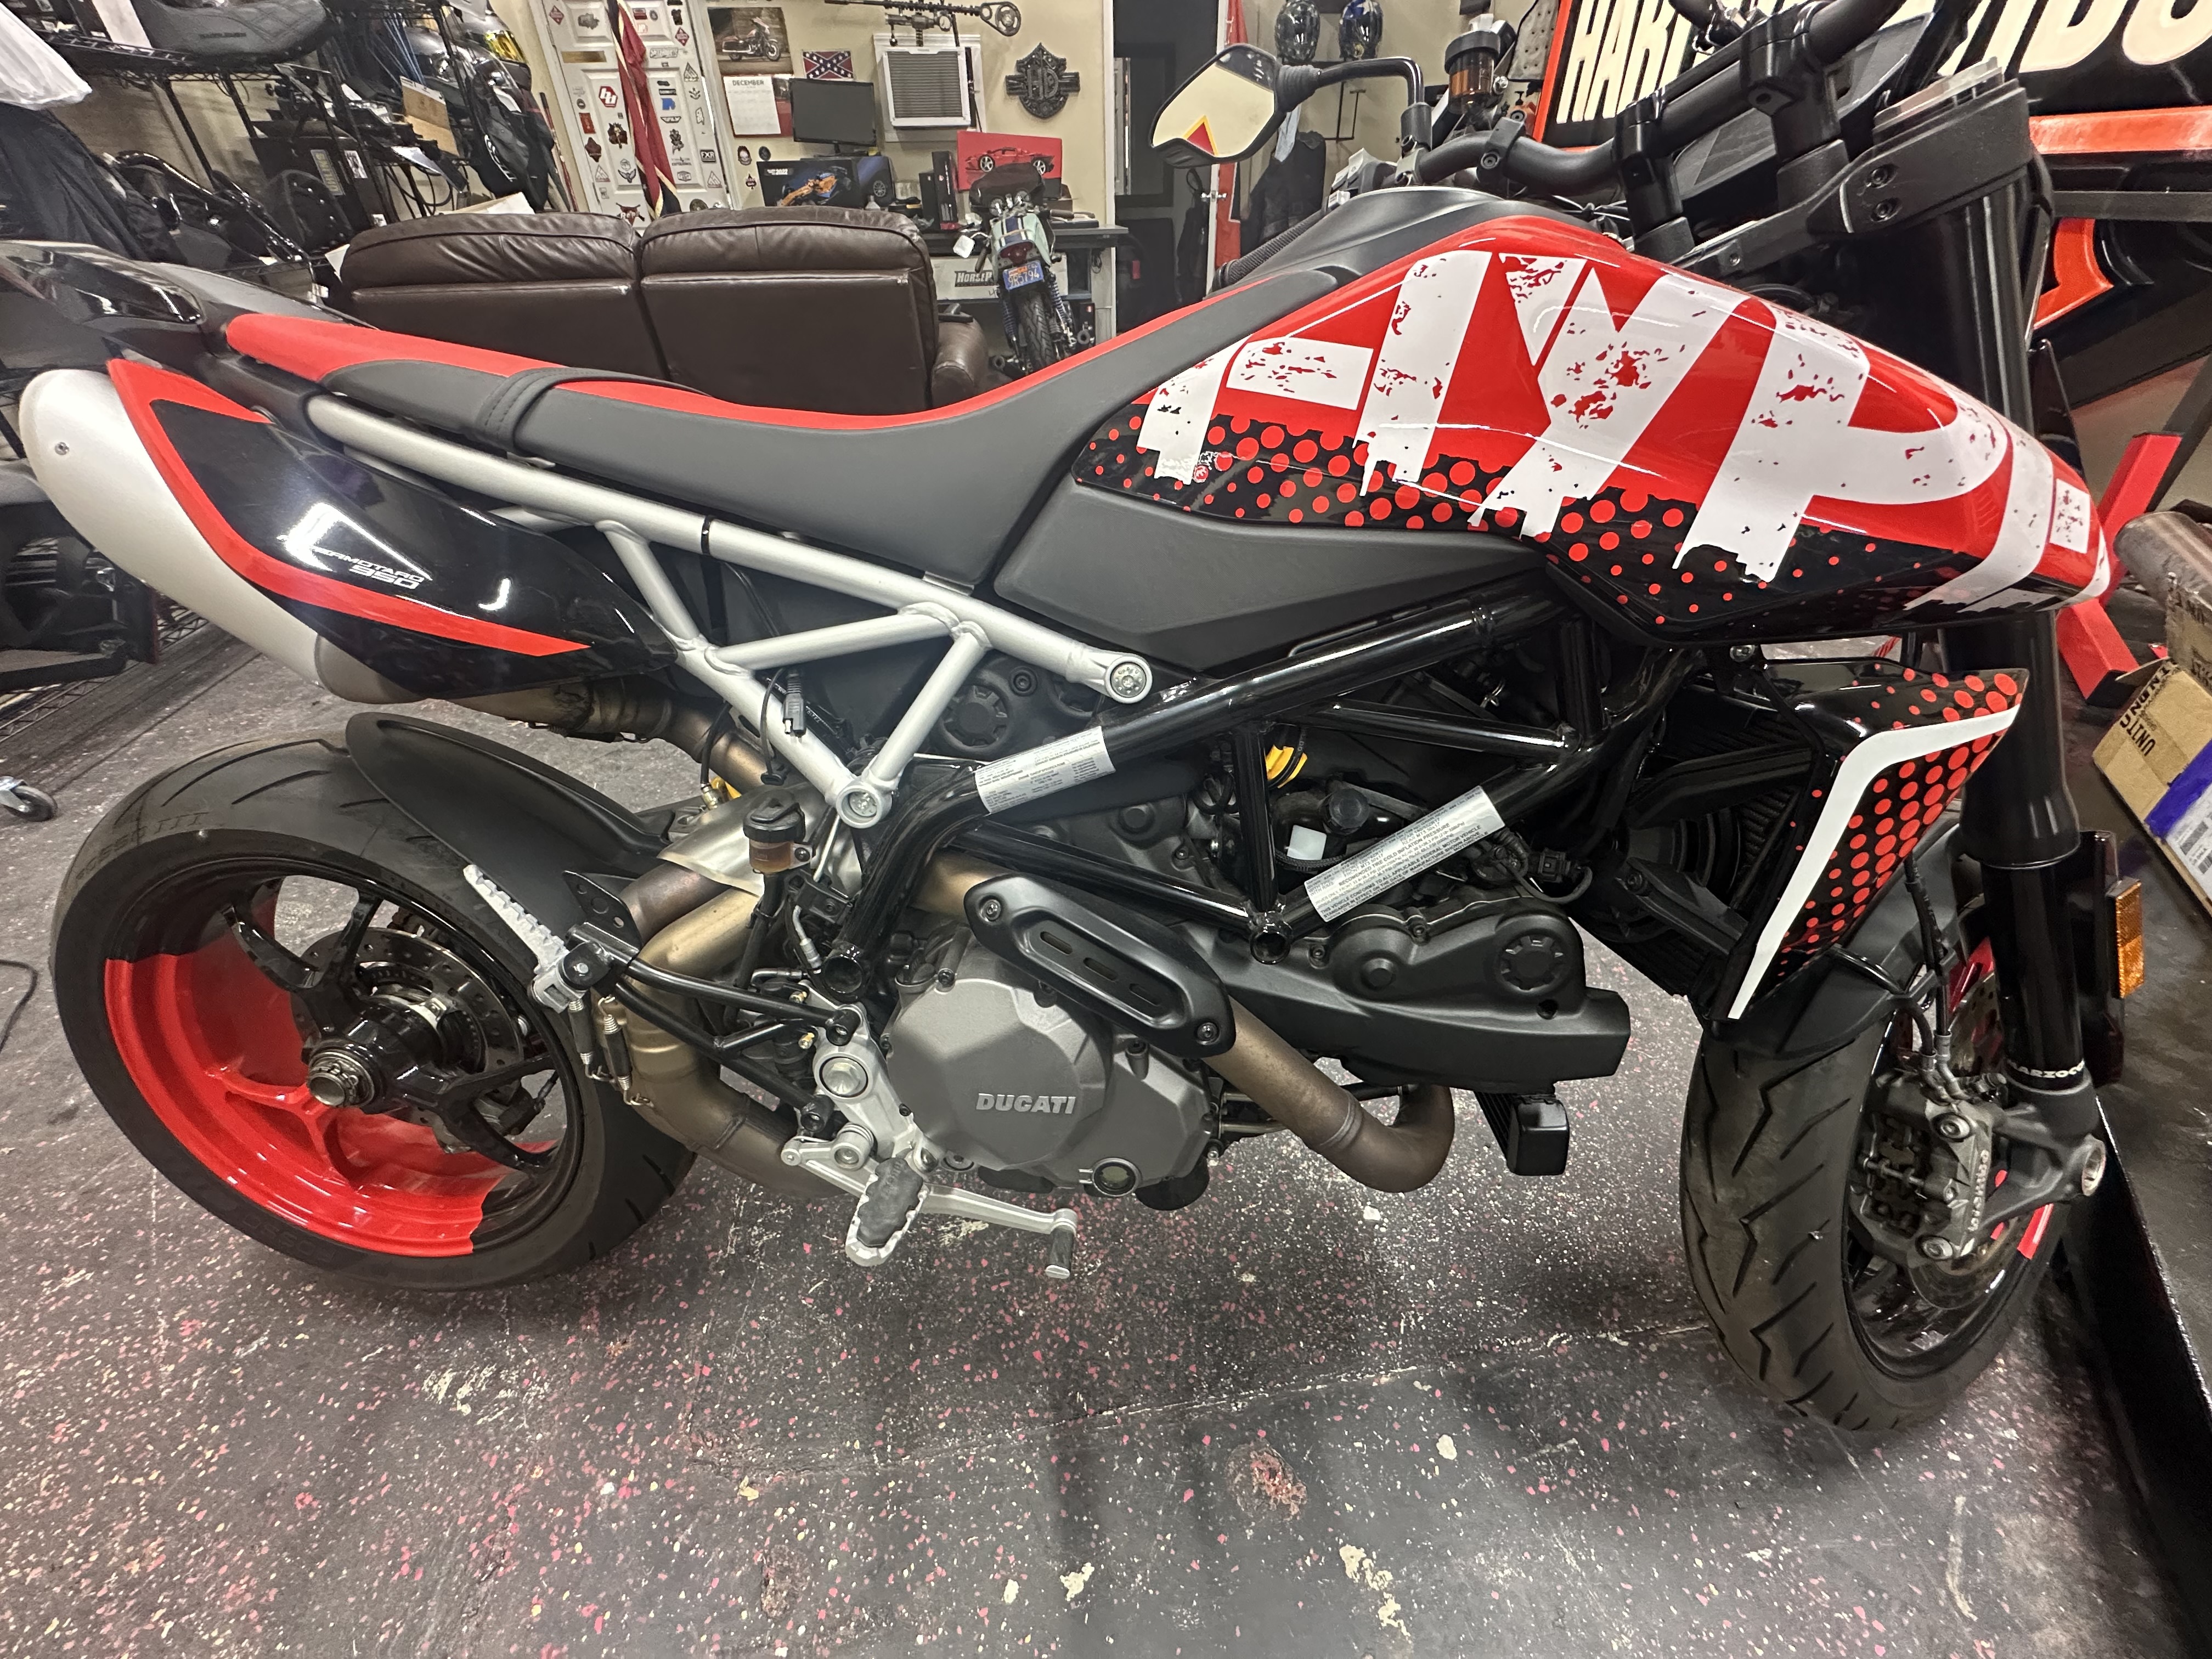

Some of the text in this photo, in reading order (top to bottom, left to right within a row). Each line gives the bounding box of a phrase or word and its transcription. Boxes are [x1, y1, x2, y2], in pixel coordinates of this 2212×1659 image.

[957, 271, 992, 282] HORSEP
[348, 564, 421, 590] 950
[1397, 837, 1423, 854] INFLATION
[1423, 822, 1450, 840] PRESSURE
[1330, 896, 1350, 909] VEHICLE
[1391, 857, 1420, 876] APPLICABLE
[1420, 845, 1442, 860] FEDERAL
[1442, 836, 1460, 848] MOTOR
[1459, 824, 1481, 838] VEHICLE
[975, 1092, 1077, 1115] DUCATI
